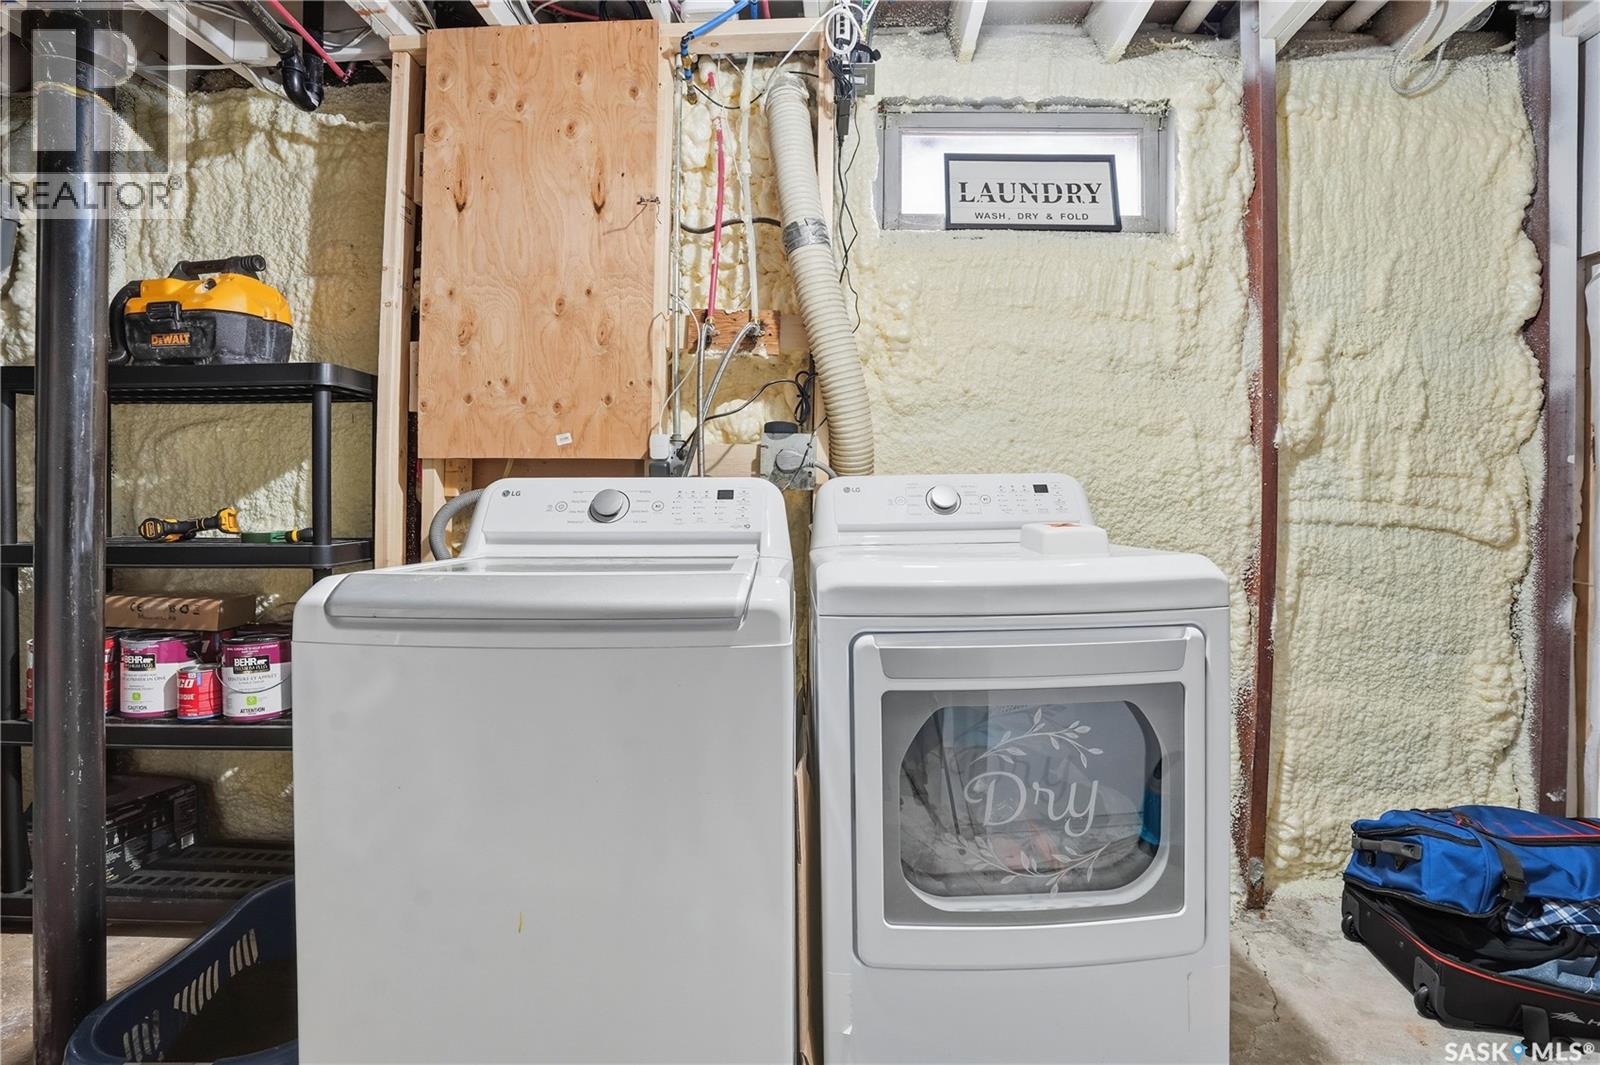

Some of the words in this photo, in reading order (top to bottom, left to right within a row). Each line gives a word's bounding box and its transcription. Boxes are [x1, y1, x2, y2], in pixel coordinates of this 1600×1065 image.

[958, 181, 1102, 204] LAUNDRY
[1017, 212, 1039, 220] DRY
[1060, 213, 1089, 221] FOLD
[124, 655, 143, 664] BEHR
[234, 657, 257, 667] BEHR
[963, 769, 1100, 837] Dry
